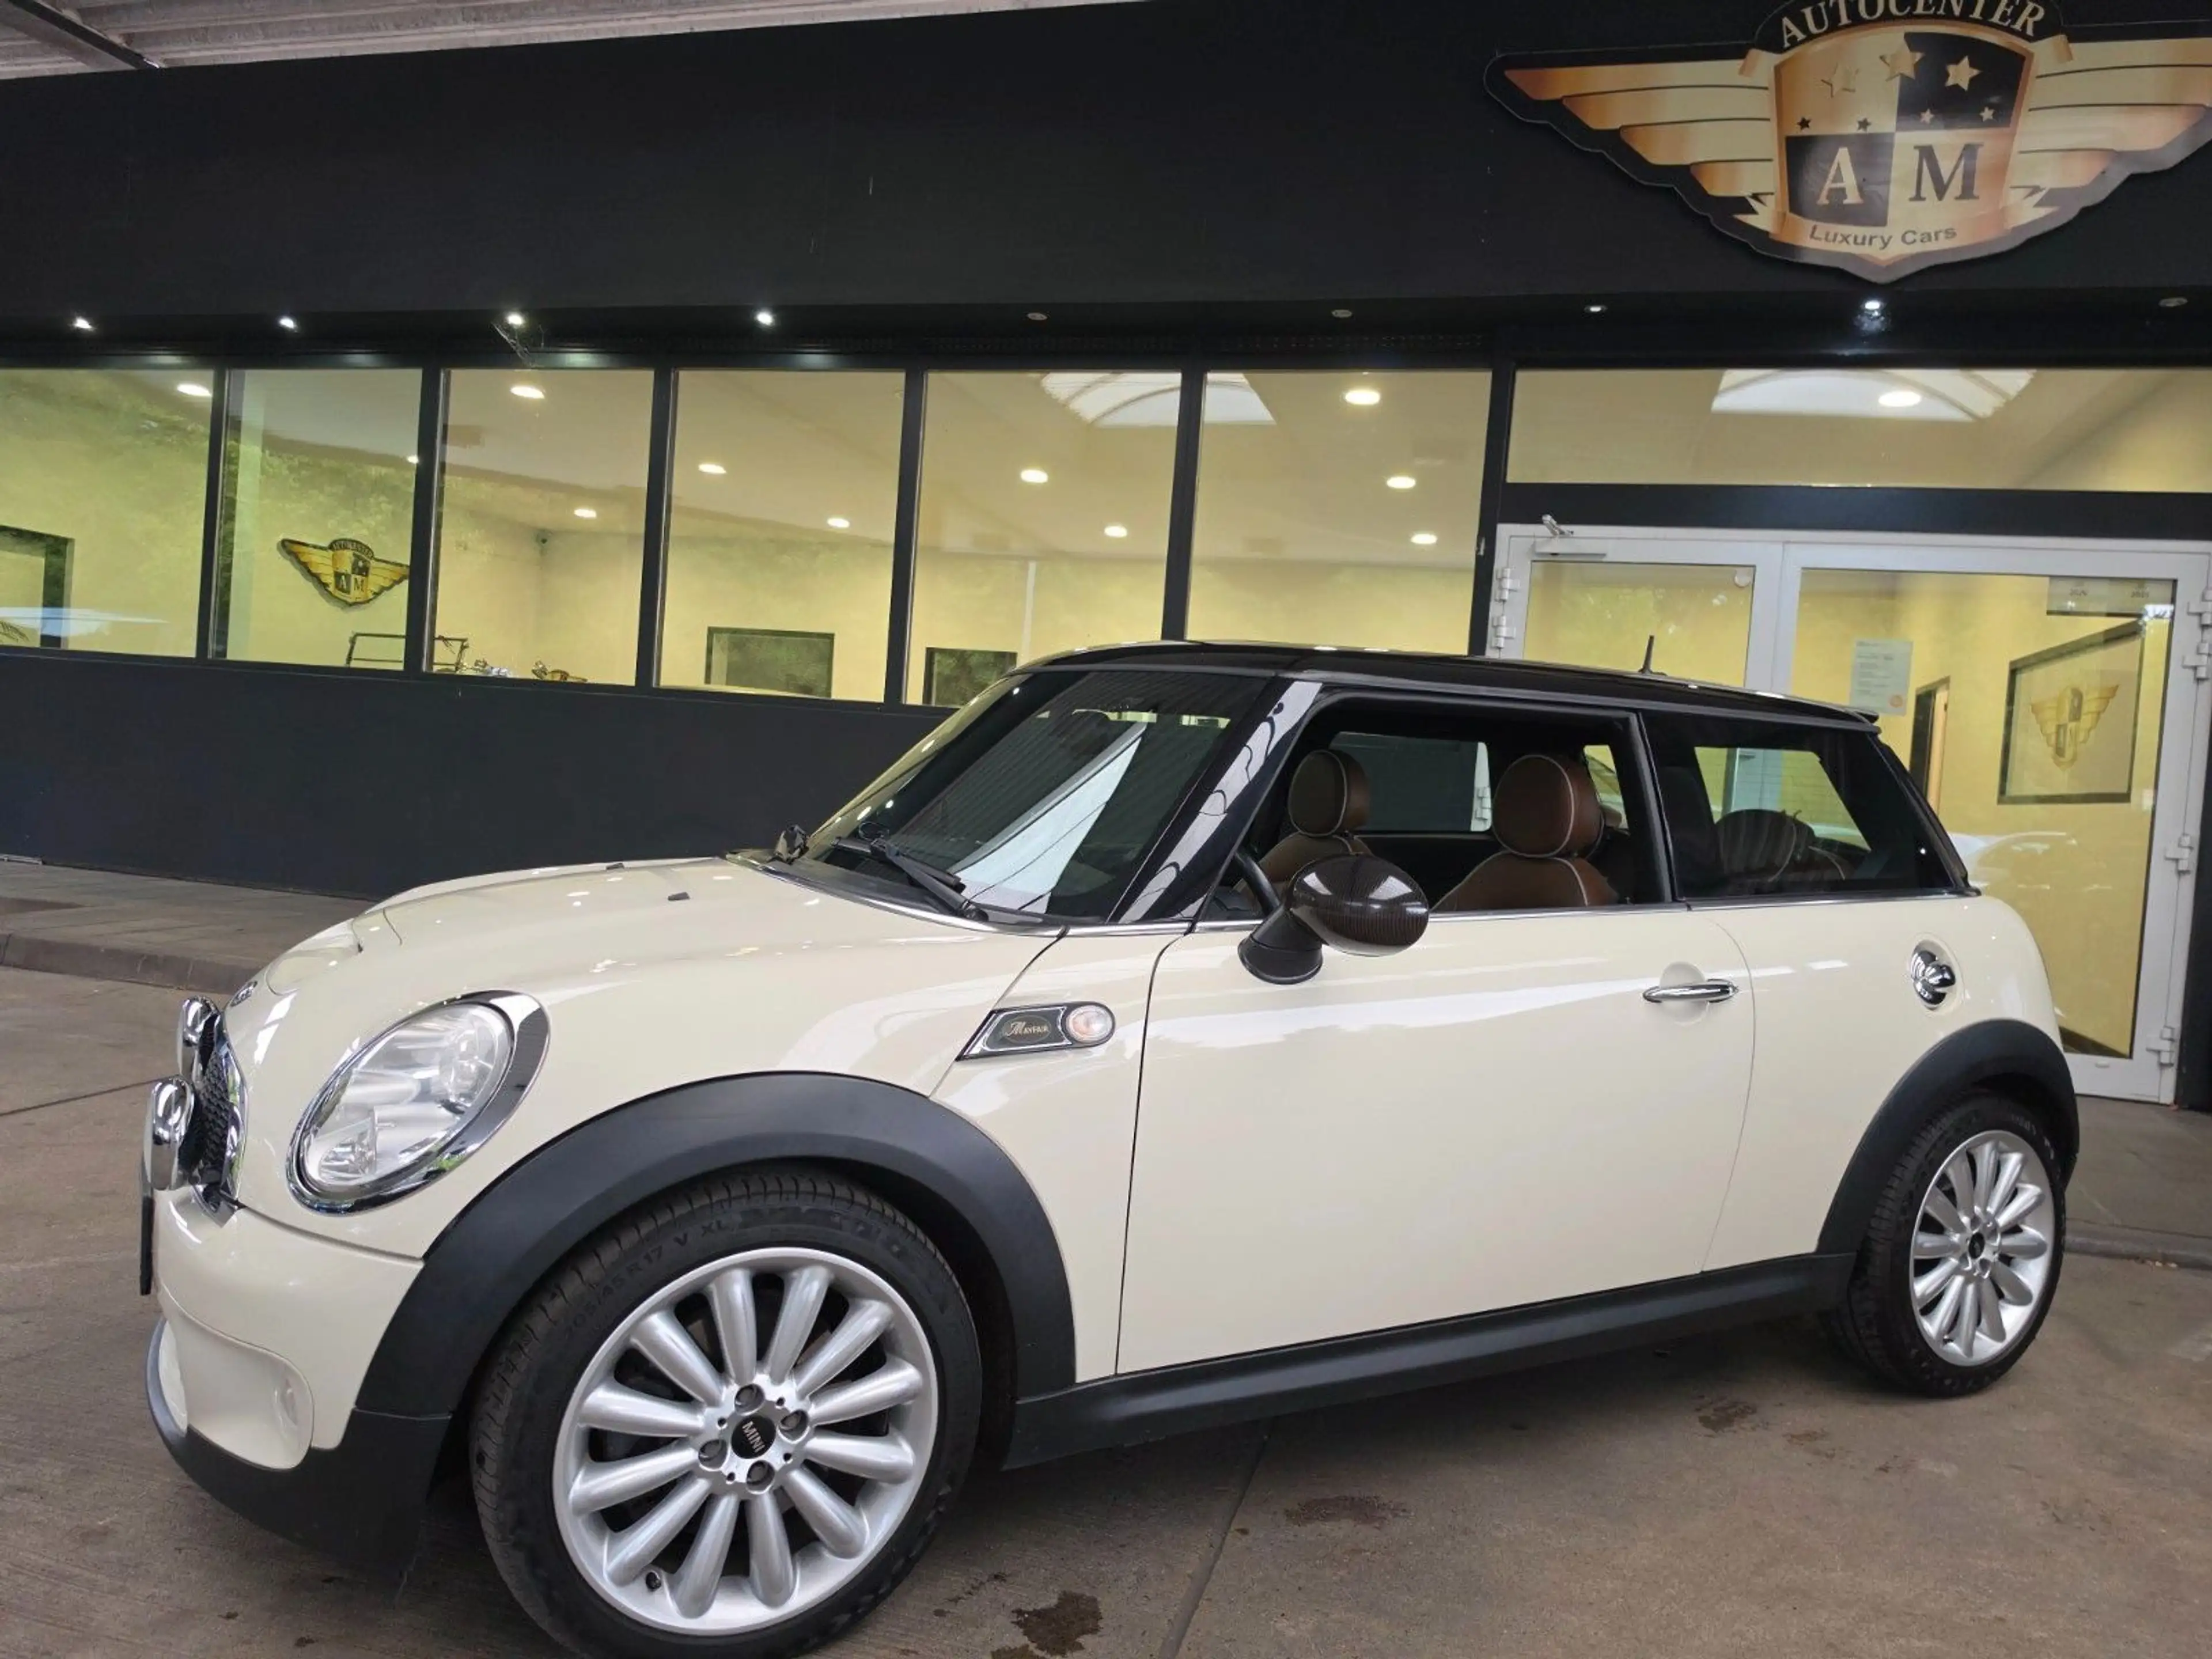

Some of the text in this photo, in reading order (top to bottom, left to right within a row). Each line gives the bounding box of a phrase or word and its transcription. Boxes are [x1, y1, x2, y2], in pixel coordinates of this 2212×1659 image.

[1809, 224, 1957, 250] Luxury Cars
[741, 1421, 766, 1453] MINI
